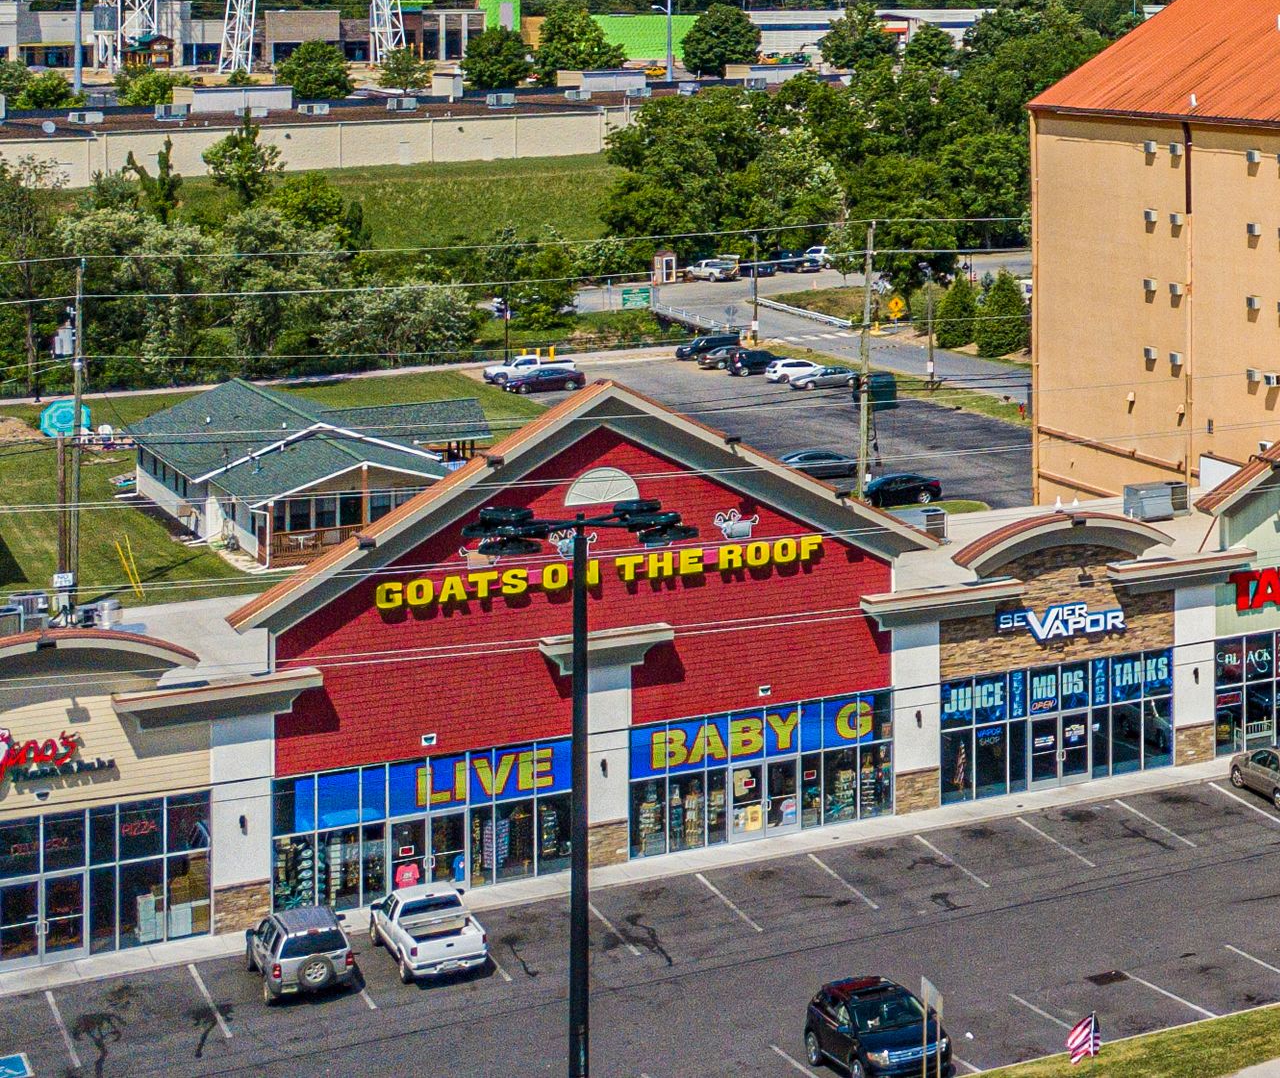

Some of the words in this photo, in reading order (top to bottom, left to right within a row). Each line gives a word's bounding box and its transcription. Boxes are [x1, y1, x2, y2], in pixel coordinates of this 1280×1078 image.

[376, 568, 528, 610] GOATS
[616, 548, 703, 582] THE
[718, 535, 823, 569] ROOF
[1032, 671, 1084, 700] MODS
[1095, 660, 1105, 702] VAPOR
[1114, 657, 1168, 687] TANKS
[944, 683, 1004, 713] JUICE
[1032, 700, 1054, 710] OPEN
[416, 748, 554, 806] LIVE
[650, 710, 800, 769] BABY
[835, 701, 873, 739] G
[121, 820, 160, 837] PIZZA
